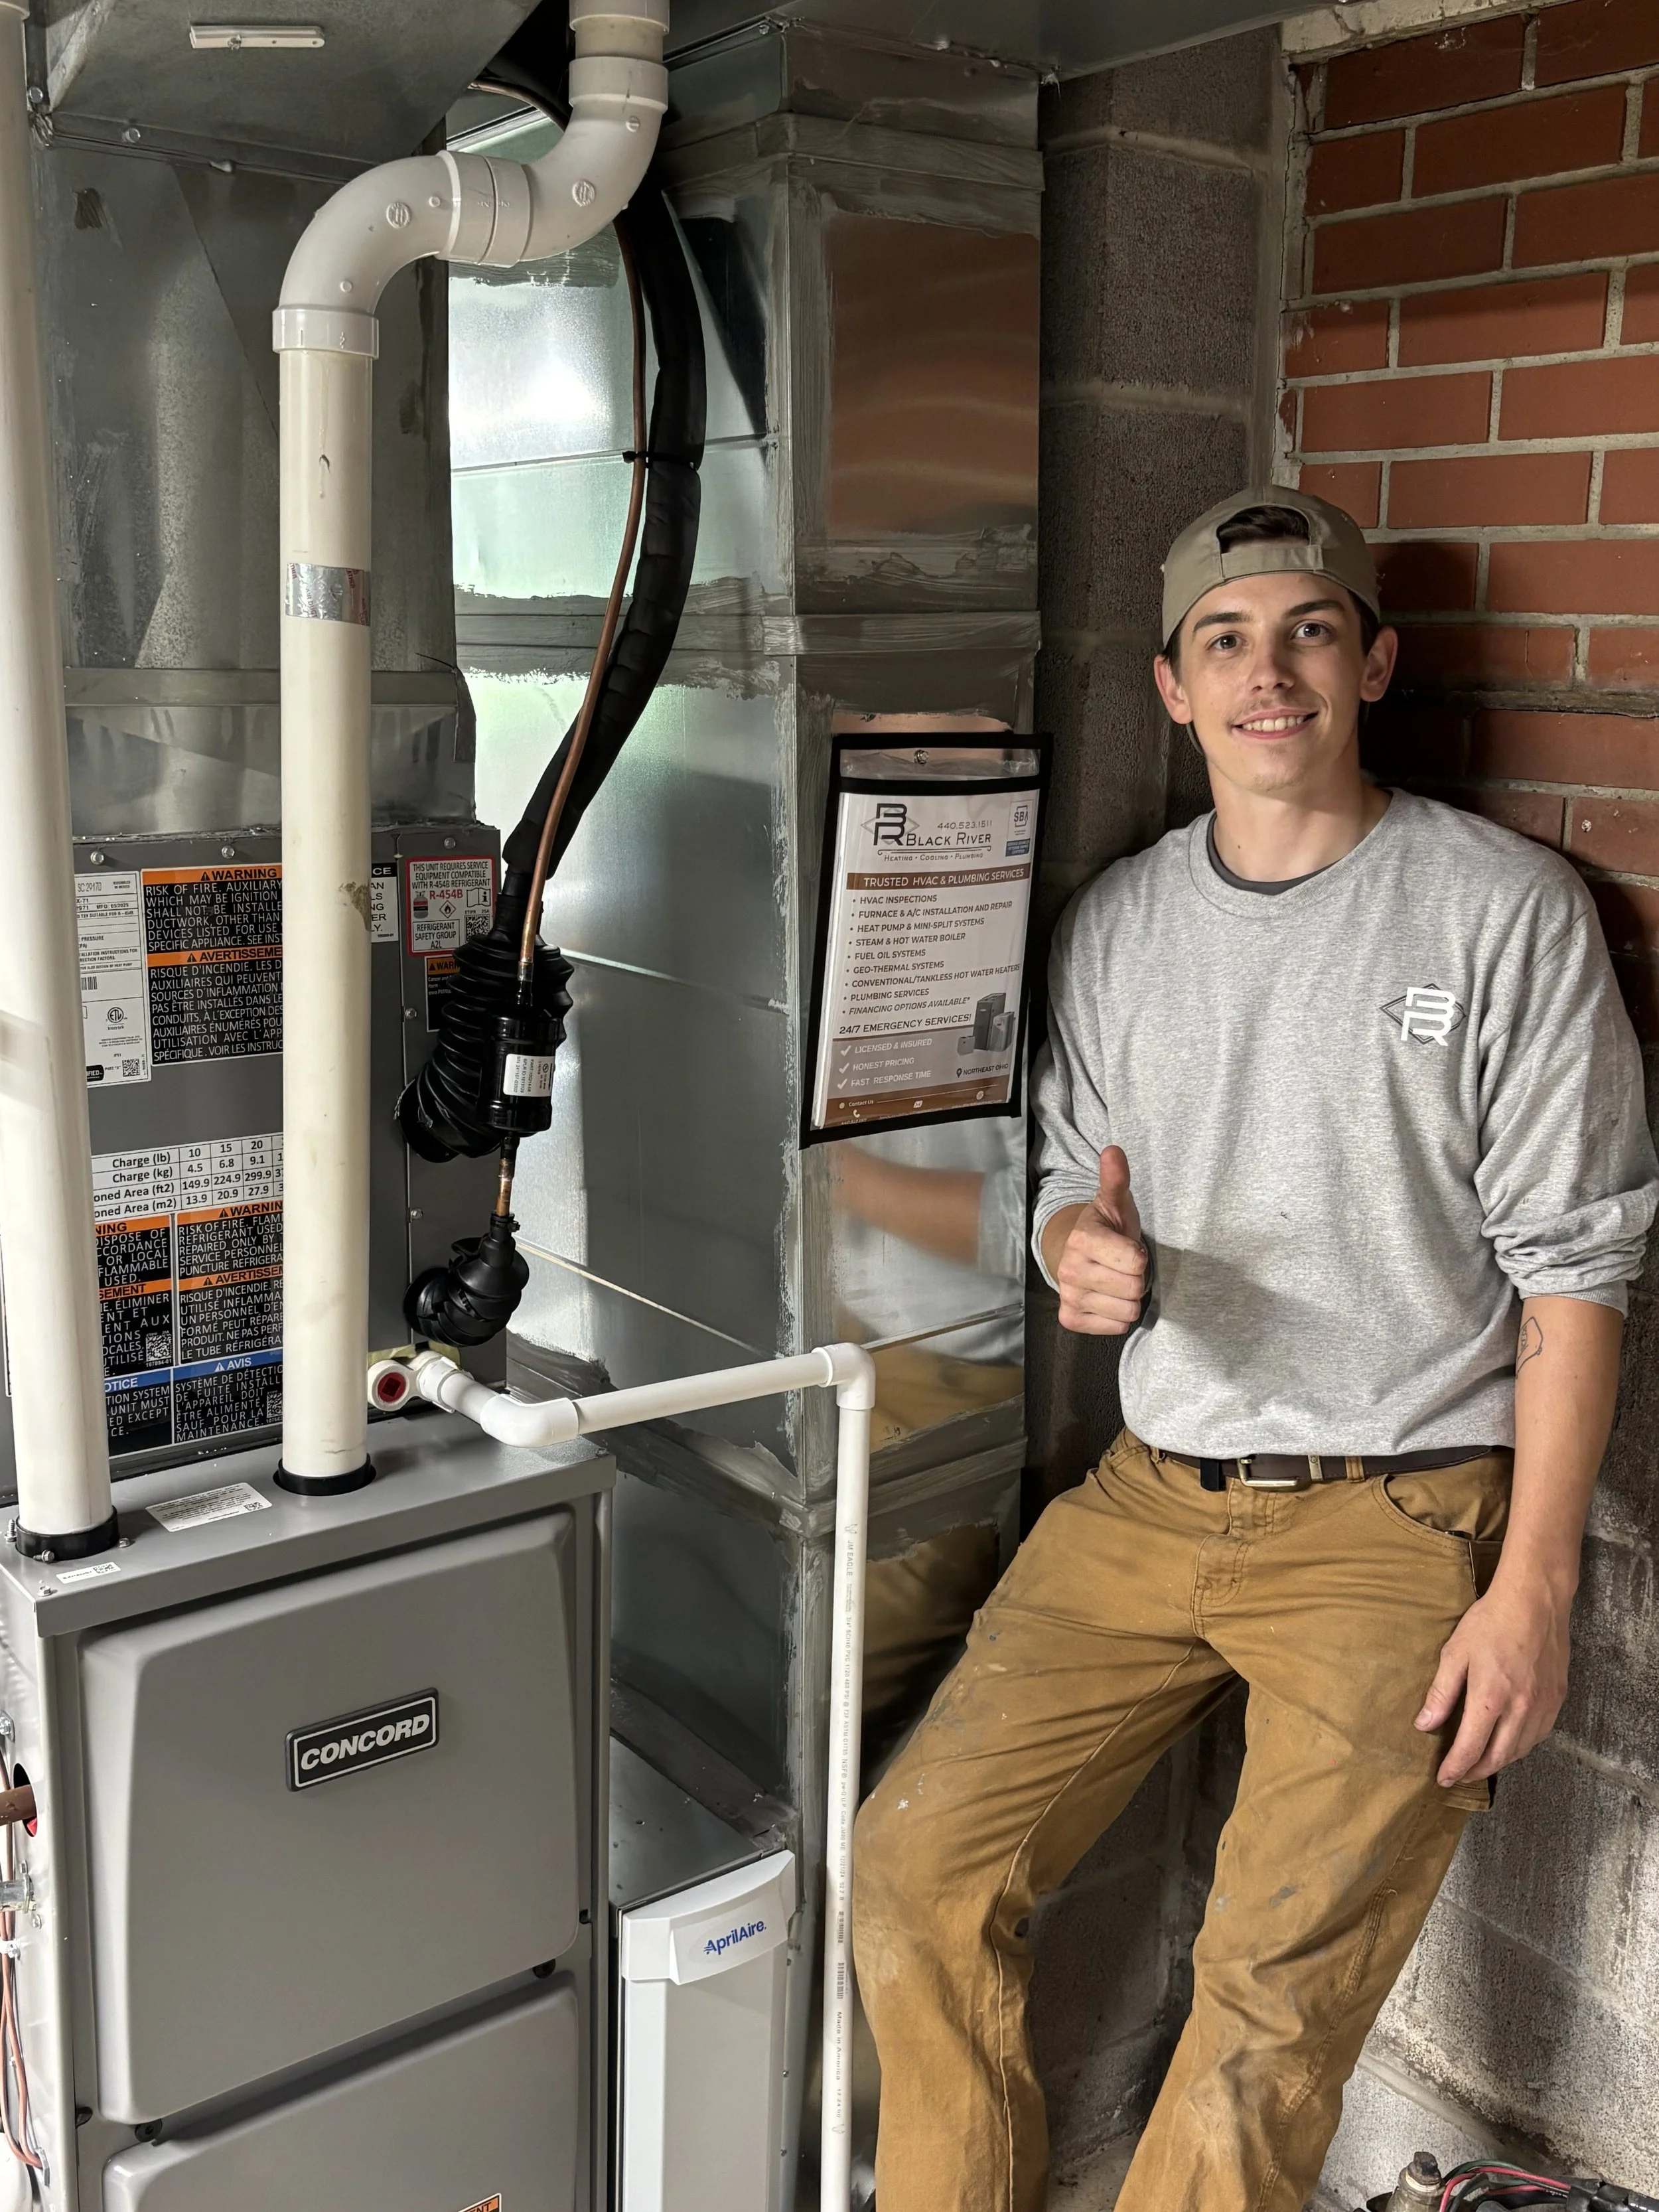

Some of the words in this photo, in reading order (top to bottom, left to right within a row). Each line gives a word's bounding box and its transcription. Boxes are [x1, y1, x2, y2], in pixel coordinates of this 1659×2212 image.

[906, 834, 950, 846] BLACK
[956, 832, 991, 845] RIVER
[212, 869, 277, 880] WARNING
[415, 872, 449, 881] EQUIPMENT
[451, 870, 486, 879] COMPATIBLE
[864, 877, 908, 887] TRUSTED
[913, 877, 938, 886] HVAC
[940, 876, 946, 885] &
[949, 873, 989, 884] PLUMBING
[991, 869, 1024, 881] SERVICES
[146, 885, 169, 896] RISK
[174, 885, 187, 894] OF
[193, 883, 221, 893] FIRE.
[226, 880, 282, 891] AUXILIARY
[429, 880, 449, 889] R-454B
[451, 879, 490, 887] REFRIGERANT
[146, 896, 183, 907] WHICH
[190, 895, 211, 905] MAY
[216, 893, 228, 903] BE
[232, 891, 277, 902] IGNITION
[430, 889, 463, 899] R-454B
[147, 907, 181, 919] SHALL
[214, 905, 226, 914] BE
[923, 905, 973, 916] INSTALLATION
[991, 901, 1012, 911] REPAIR
[148, 917, 212, 929] DUCTWORK,
[216, 915, 249, 925] OTHER
[252, 913, 279, 922] THAN
[417, 922, 454, 931] REFRIGERANT
[914, 921, 953, 930] MINI-SPLIT
[955, 918, 984, 927] SYSTEMS
[149, 929, 192, 940] DEVICES
[196, 926, 229, 937] LISTED
[236, 924, 255, 934] FOR
[259, 923, 277, 933] USE
[912, 935, 938, 944] WATER
[940, 933, 965, 942] BOILER
[149, 940, 188, 951] SPECIFIC
[192, 936, 244, 949] APPLIANCE.
[248, 935, 263, 944] SEE
[892, 949, 926, 958] SYSTEMS
[151, 966, 188, 979] RISQUE
[192, 962, 252, 975] D'INCENDIE.
[256, 960, 272, 970] LES
[853, 965, 910, 974] GEO-THERMAL
[912, 961, 944, 970] SYSTEMS
[151, 976, 212, 990] AUXILIAIRES
[216, 976, 233, 986] QUI
[238, 972, 281, 983] PEUVENT
[852, 973, 952, 988] CONVENTIONAL/TANKLESS
[954, 972, 968, 980] HOT
[970, 968, 993, 978] WATER
[995, 964, 1020, 974] HEATERS
[851, 992, 892, 1001] PLUMBING
[894, 988, 929, 998] SERVICES
[153, 1003, 169, 1013] PAS
[173, 1000, 194, 1011] ÊTRE
[198, 995, 243, 1009] INSTALLÉS
[246, 995, 270, 1005] DANS
[849, 1005, 892, 1015] FINANCING
[894, 1003, 926, 1011] OPTIONS
[839, 1025, 860, 1034] 24/7
[863, 1019, 922, 1033] EMERGENCY
[855, 1043, 892, 1054] LICENSED
[901, 1039, 932, 1048] INSURED
[853, 1061, 883, 1071] HONEST
[885, 1057, 914, 1067] PRICING
[964, 1065, 994, 1075] NORTHEAST
[851, 1078, 869, 1087] FAST
[873, 1073, 912, 1084] RESPONSE
[113, 1155, 149, 1168] Charge
[153, 1152, 170, 1165] (lb)
[189, 1148, 200, 1157] 10
[221, 1144, 232, 1153] 15
[252, 1140, 263, 1149] 20
[113, 1171, 149, 1183] Charge
[154, 1166, 173, 1179] (kg)
[187, 1163, 202, 1173] 4.5
[220, 1159, 234, 1168] 6.8
[250, 1155, 264, 1165] 9.1
[124, 1187, 149, 1199] Area
[153, 1183, 174, 1195] (ft2)
[182, 1179, 209, 1190] 149.9
[214, 1173, 241, 1185] 224.9
[245, 1169, 271, 1181] 299.9
[125, 1203, 149, 1214] Area
[153, 1198, 177, 1211] (m2)
[186, 1195, 207, 1205] 13.9
[218, 1189, 238, 1200] 20.9
[249, 1186, 268, 1196] 27.9
[179, 1224, 202, 1236] RISK
[205, 1222, 218, 1232] OF
[222, 1218, 248, 1230] FIRE.
[179, 1226, 252, 1245] REFRIGERANT
[257, 1223, 283, 1234] USED
[179, 1241, 226, 1256] REPAIRED
[232, 1236, 256, 1248] ONLY
[263, 1234, 274, 1244] BY
[226, 1358, 252, 1370] AVIS
[301, 1714, 430, 1770] CONCORD
[703, 1921, 764, 1955] AprilAire
